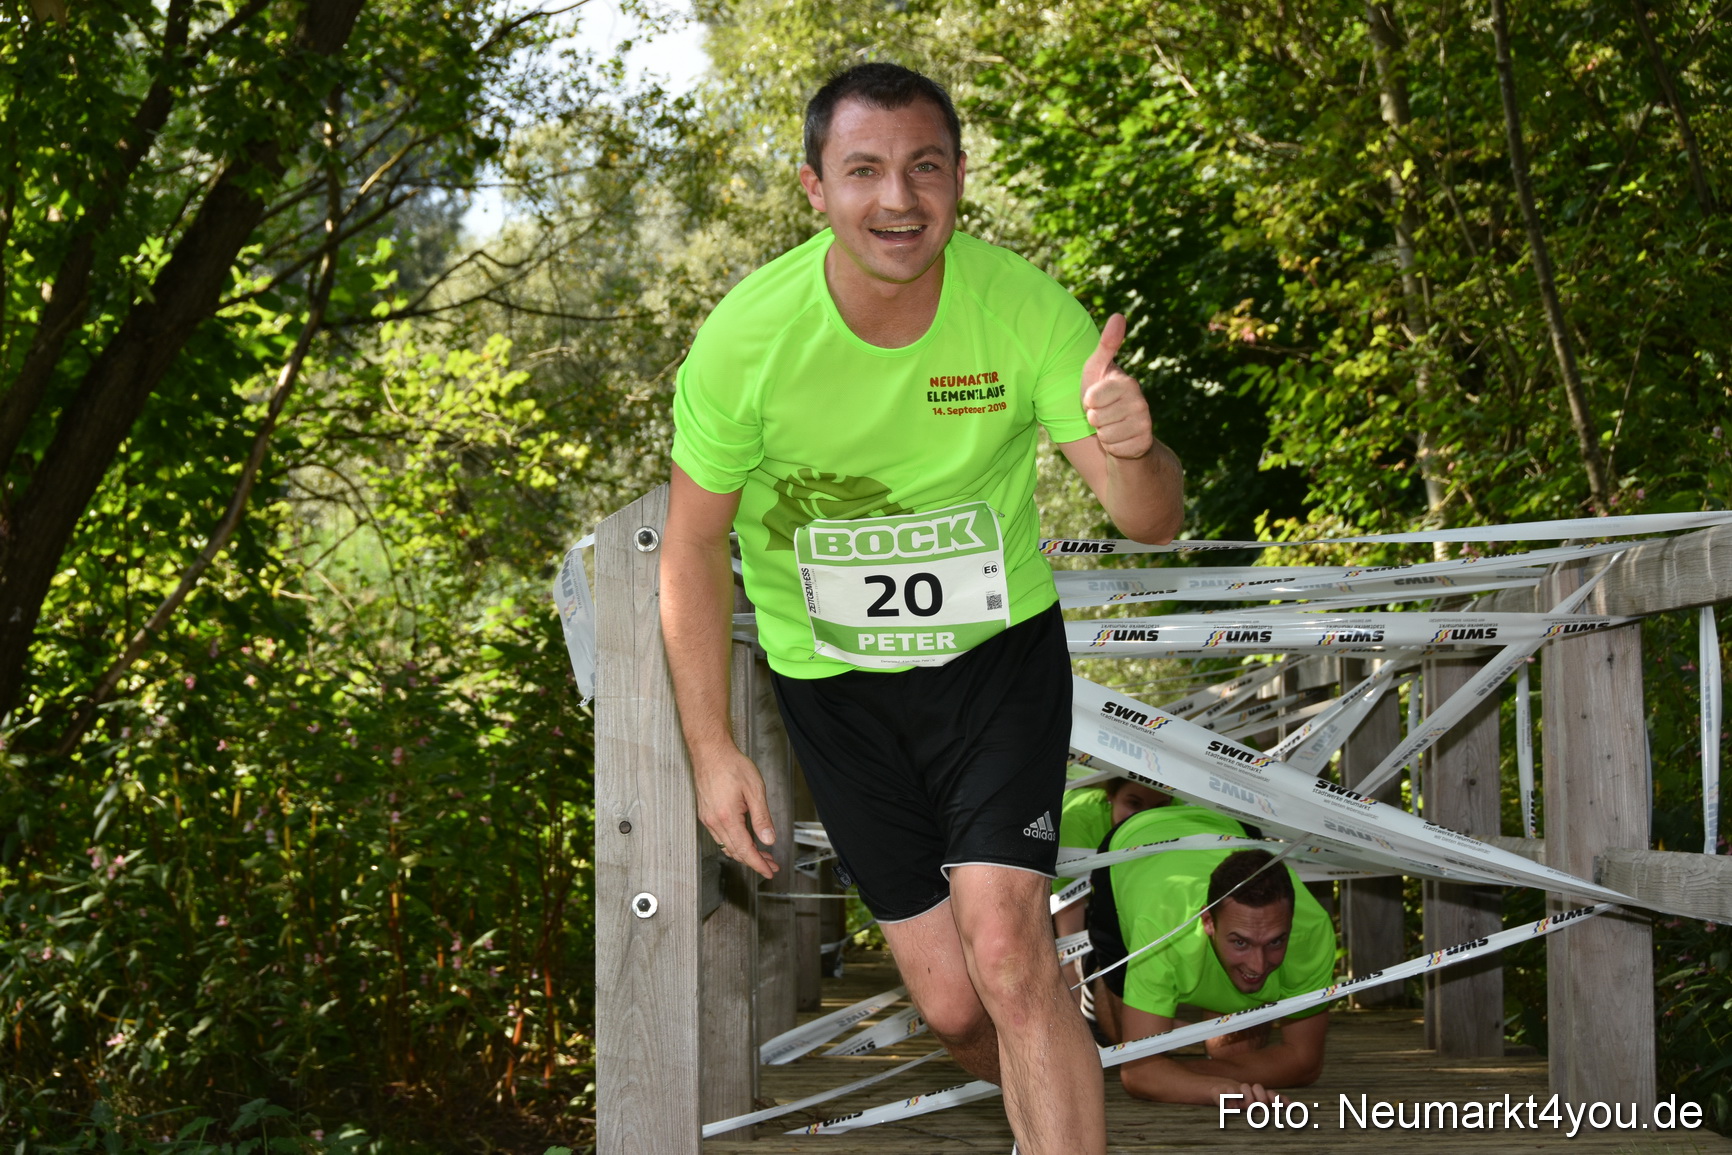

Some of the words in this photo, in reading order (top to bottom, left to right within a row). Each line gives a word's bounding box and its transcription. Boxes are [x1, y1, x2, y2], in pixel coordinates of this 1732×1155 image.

[932, 407, 946, 415] 14.
[988, 402, 1007, 413] 2019
[811, 511, 985, 561] BOCK
[1061, 541, 1116, 553] swn
[984, 564, 998, 574] E6
[865, 572, 943, 617] 20
[1113, 629, 1159, 642] swn
[1226, 631, 1272, 643] swn
[1338, 630, 1385, 642] swn
[1451, 628, 1498, 640] swn
[858, 632, 957, 651] PETER
[1102, 701, 1148, 726] swn
[1208, 741, 1254, 763] swn
[1235, 761, 1262, 774] neumarkt
[1315, 780, 1362, 801] swn
[1344, 799, 1371, 811] neumarkt
[1023, 827, 1056, 841] adidas
[1554, 905, 1595, 924] swn
